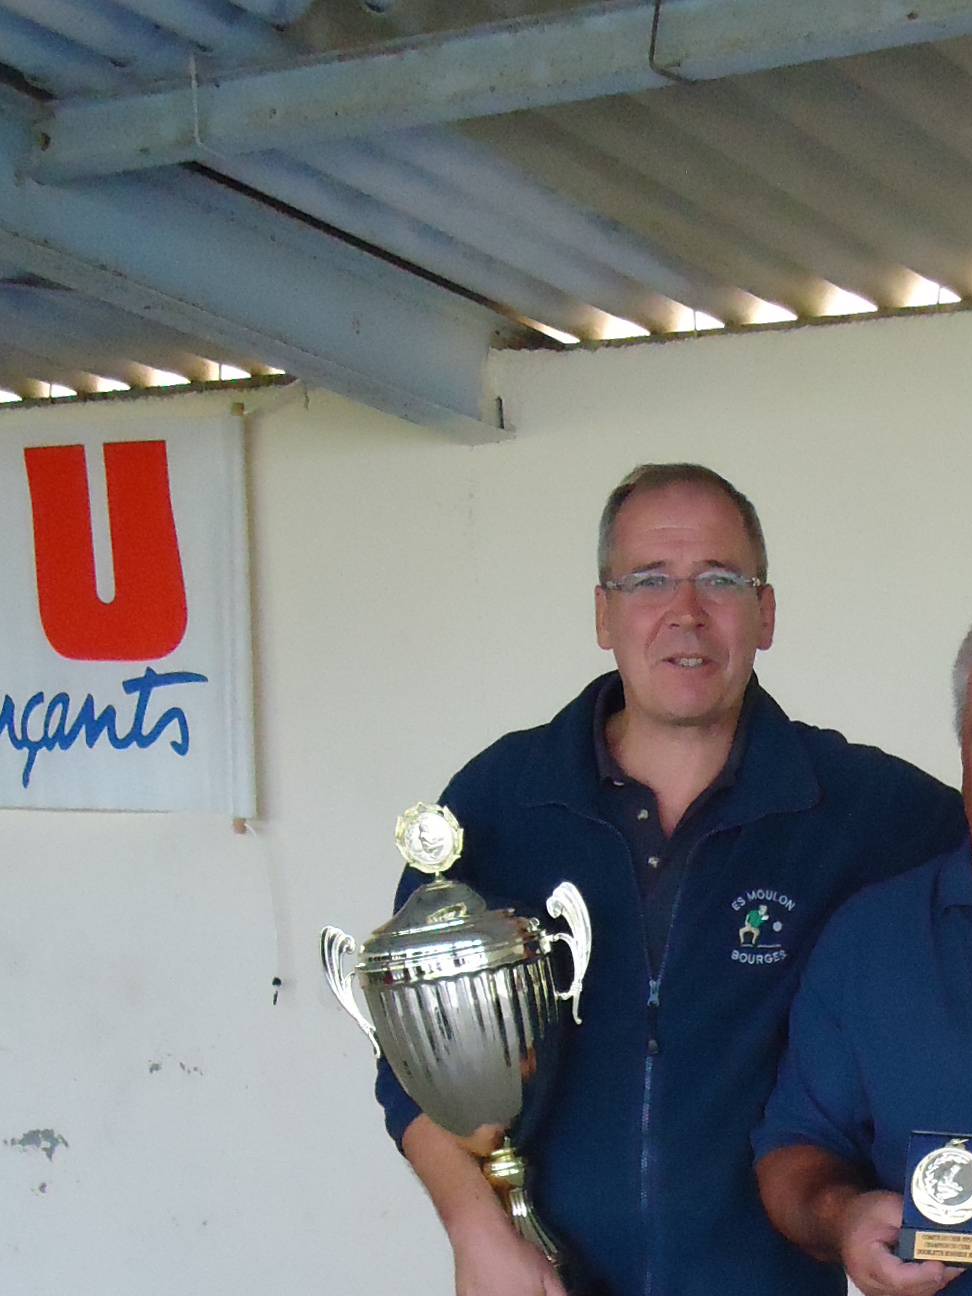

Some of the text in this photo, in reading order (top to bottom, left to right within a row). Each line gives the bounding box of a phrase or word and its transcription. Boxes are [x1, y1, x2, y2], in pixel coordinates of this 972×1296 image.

[24, 440, 188, 661] U
[731, 889, 796, 911] ES MOULON
[731, 949, 788, 965] BOURGES
